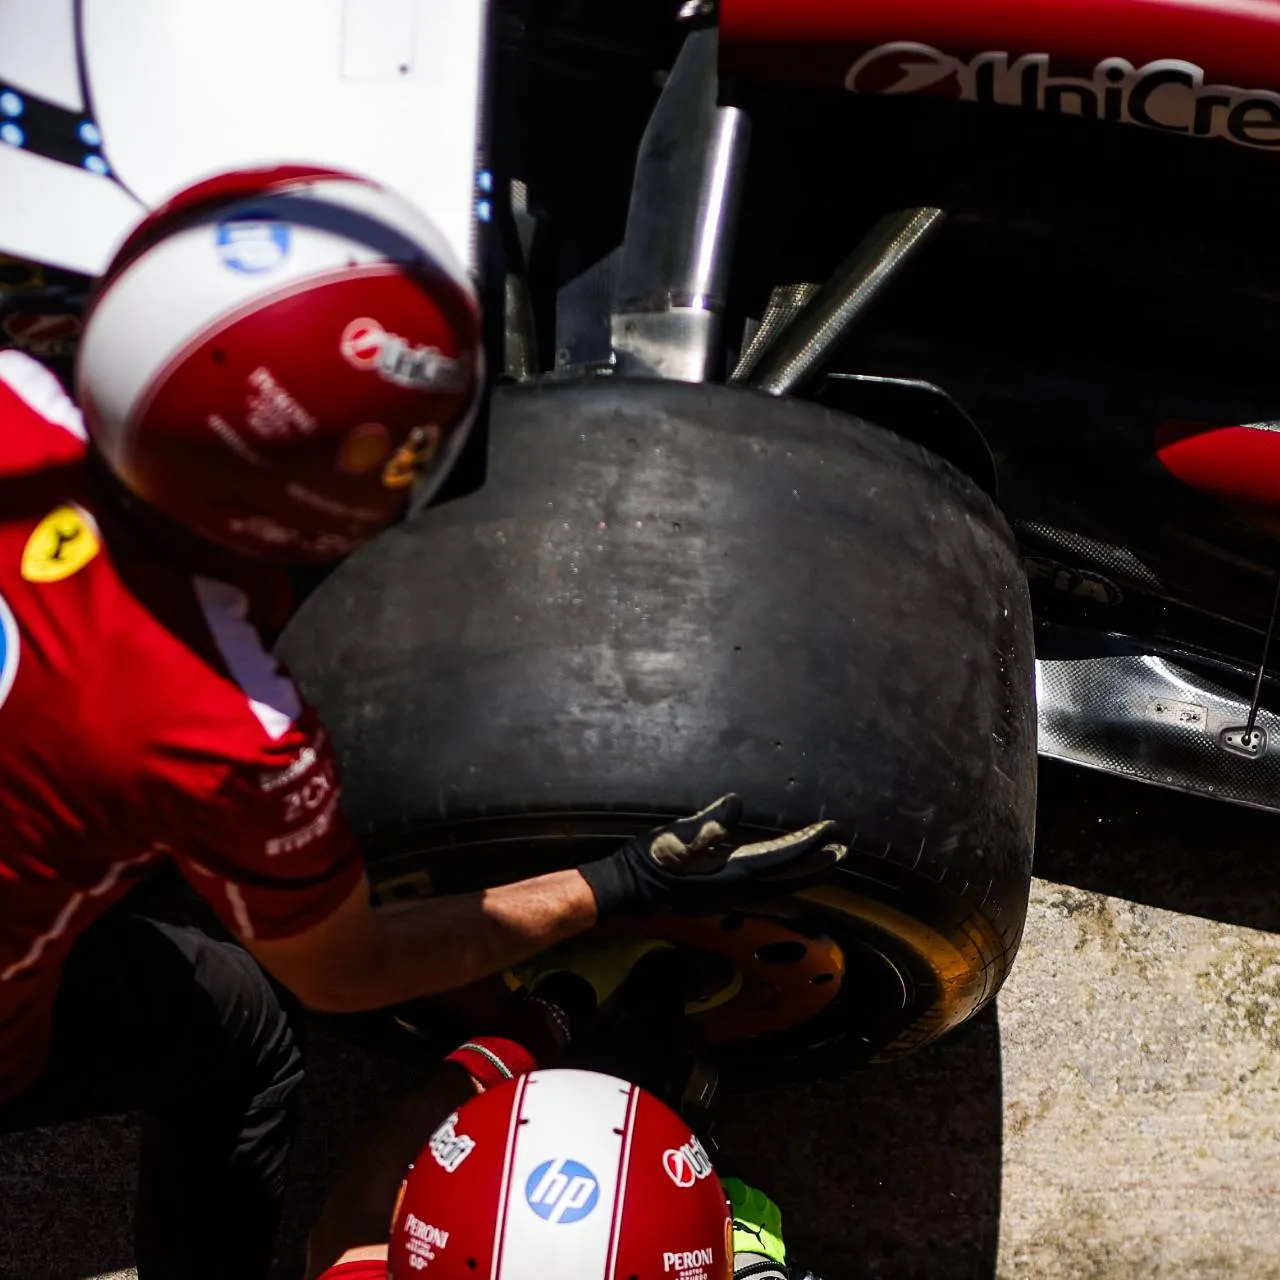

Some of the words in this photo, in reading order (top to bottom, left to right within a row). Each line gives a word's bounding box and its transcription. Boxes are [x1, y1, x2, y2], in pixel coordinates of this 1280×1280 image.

[528, 1159, 598, 1223] hp
[404, 1213, 450, 1250] PERONI
[663, 1248, 713, 1272] PERONI
